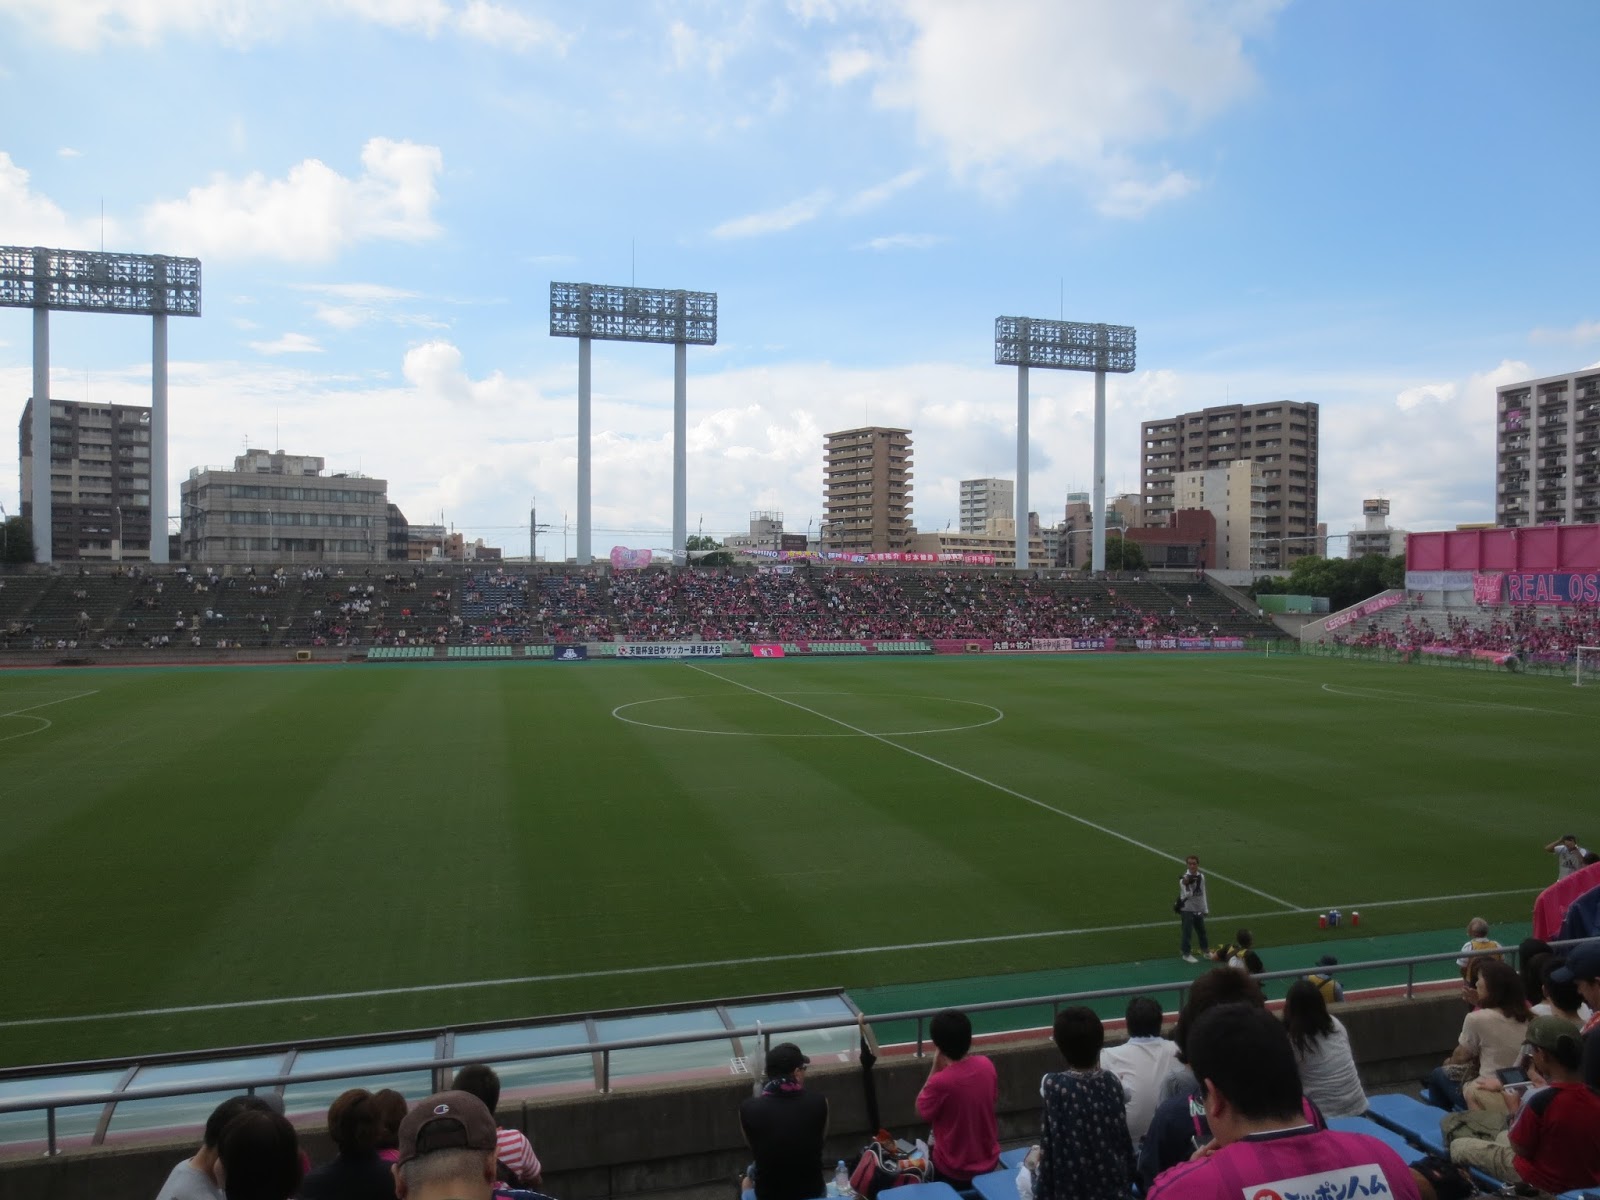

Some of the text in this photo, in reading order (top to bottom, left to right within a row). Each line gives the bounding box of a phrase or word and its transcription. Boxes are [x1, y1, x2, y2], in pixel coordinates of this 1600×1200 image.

[1508, 573, 1600, 605] REAL OS
[1324, 611, 1358, 632] CEREZO
[629, 645, 721, 655] 天皇杯全日本サッカー選手権大会
